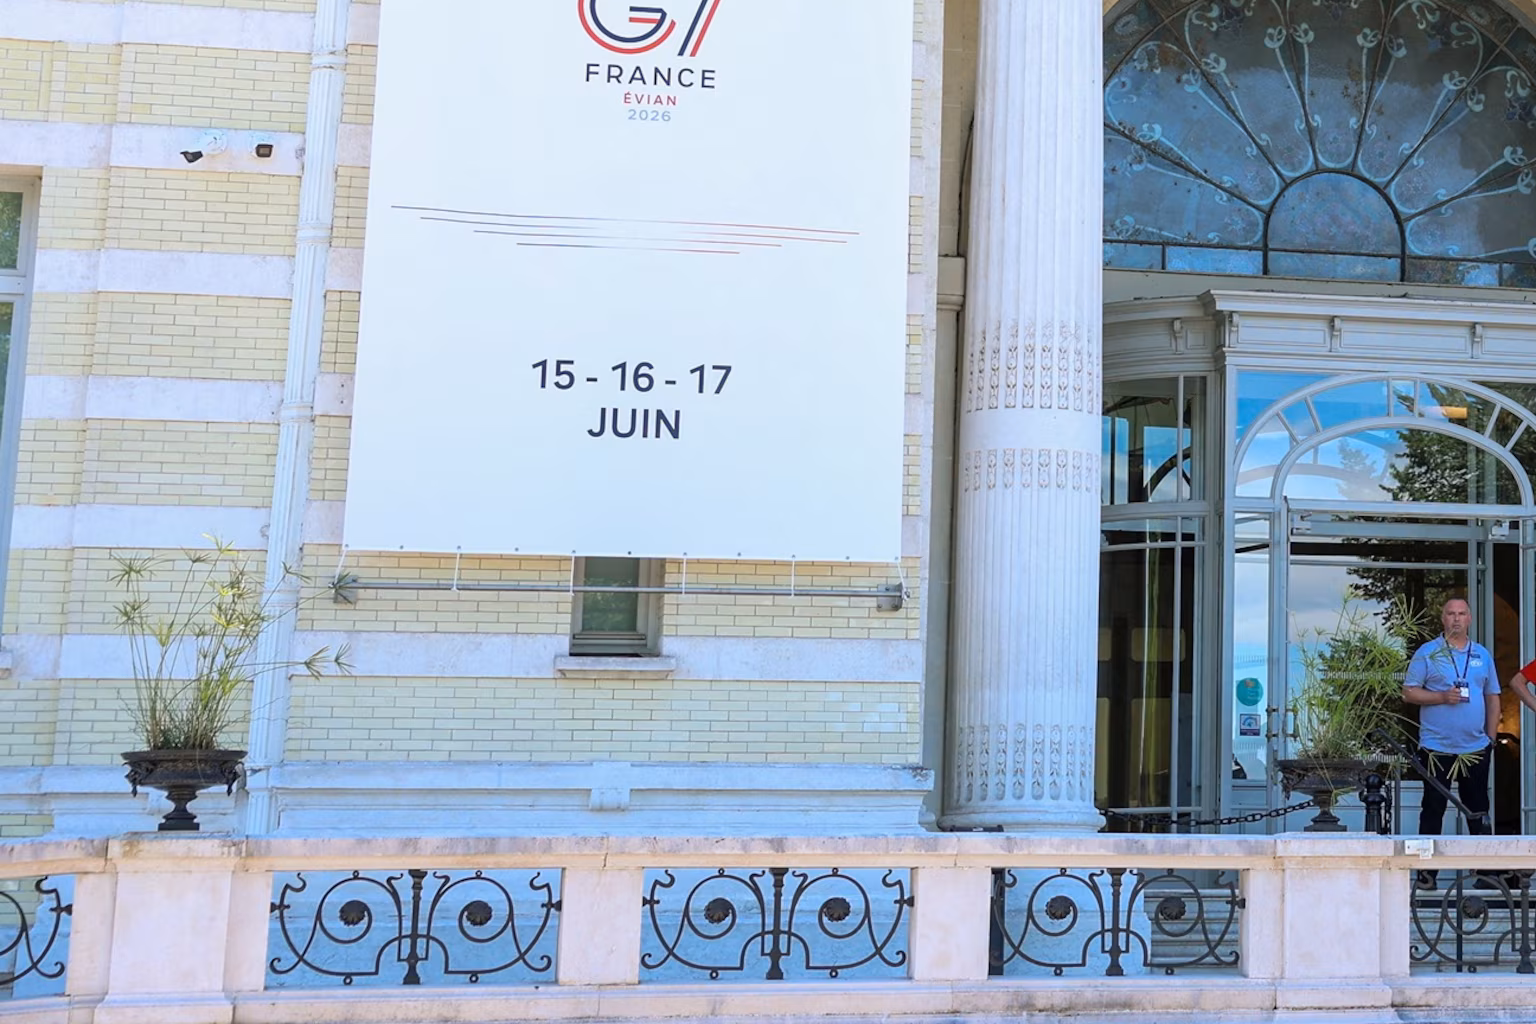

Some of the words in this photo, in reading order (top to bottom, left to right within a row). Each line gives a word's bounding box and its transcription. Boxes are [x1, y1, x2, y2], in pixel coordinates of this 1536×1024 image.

[585, 62, 716, 90] FRANCE
[623, 90, 677, 107] ÉVIAN
[627, 108, 672, 122] 2026
[586, 406, 681, 440] JUIN
